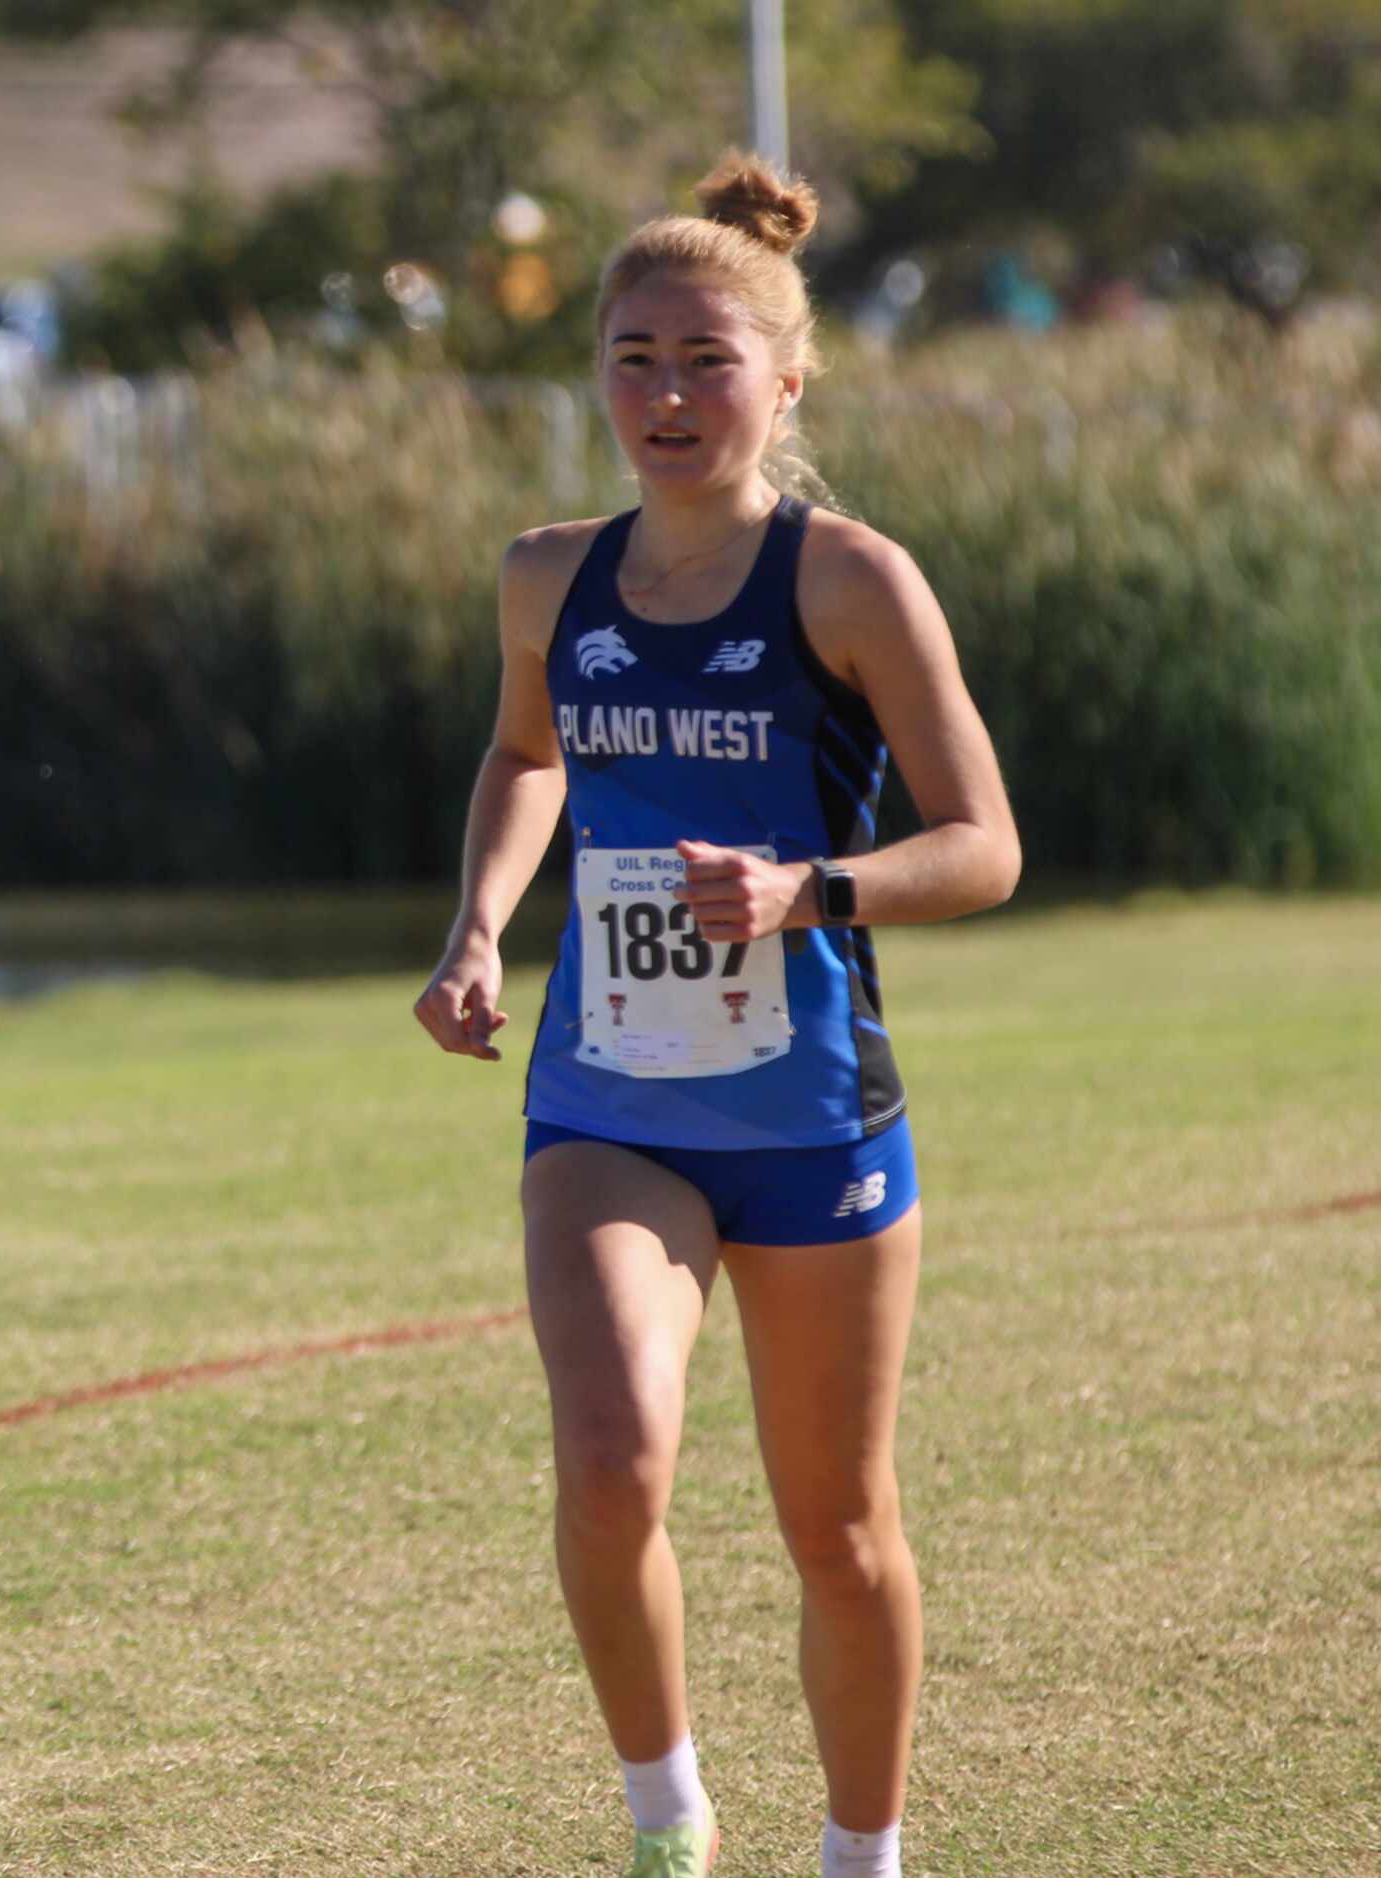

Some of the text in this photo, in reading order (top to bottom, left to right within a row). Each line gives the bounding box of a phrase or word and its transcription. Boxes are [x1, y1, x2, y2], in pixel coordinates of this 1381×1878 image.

[558, 705, 774, 761] PLANO WEST
[616, 856, 687, 872] UIL Reg
[610, 878, 655, 892] Cross
